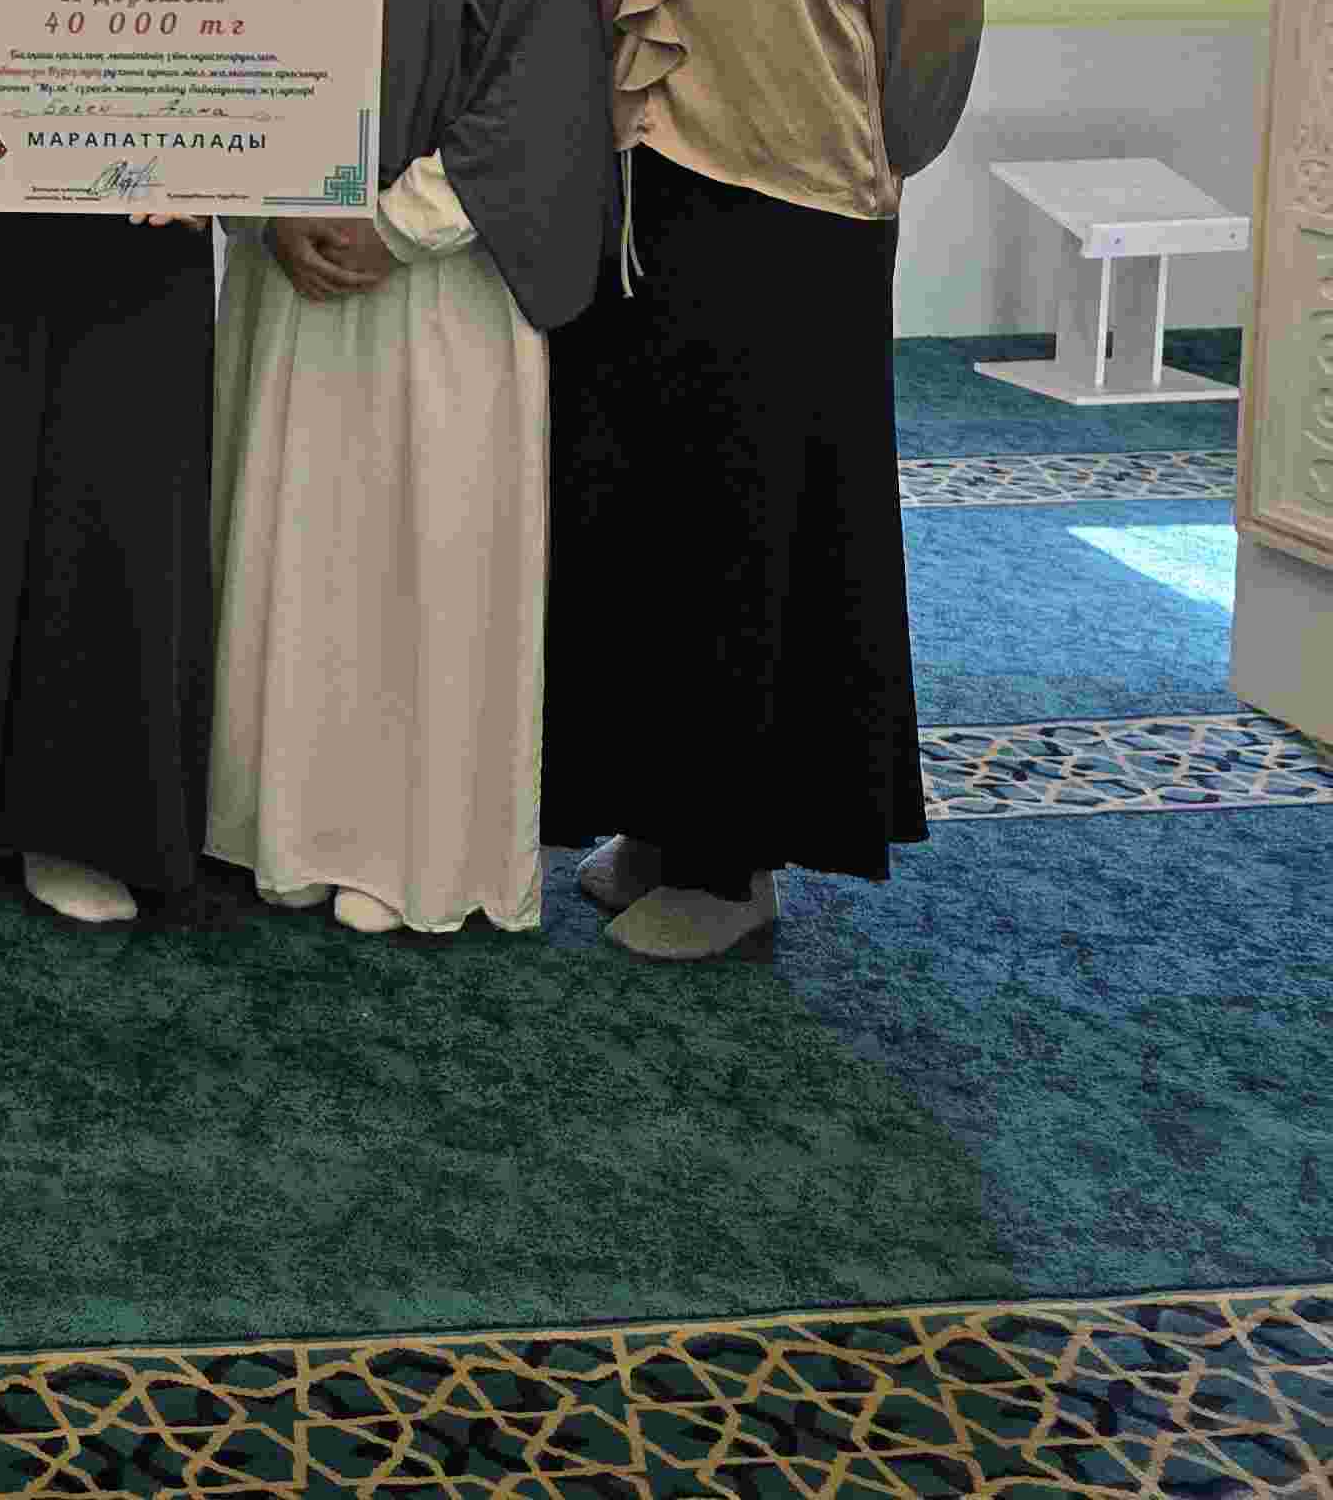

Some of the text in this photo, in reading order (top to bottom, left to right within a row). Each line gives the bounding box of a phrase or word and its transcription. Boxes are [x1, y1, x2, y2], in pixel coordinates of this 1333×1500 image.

[44, 11, 245, 36] 40 000 тг
[28, 130, 266, 152] МАРАПАТТАЛАДЫ
